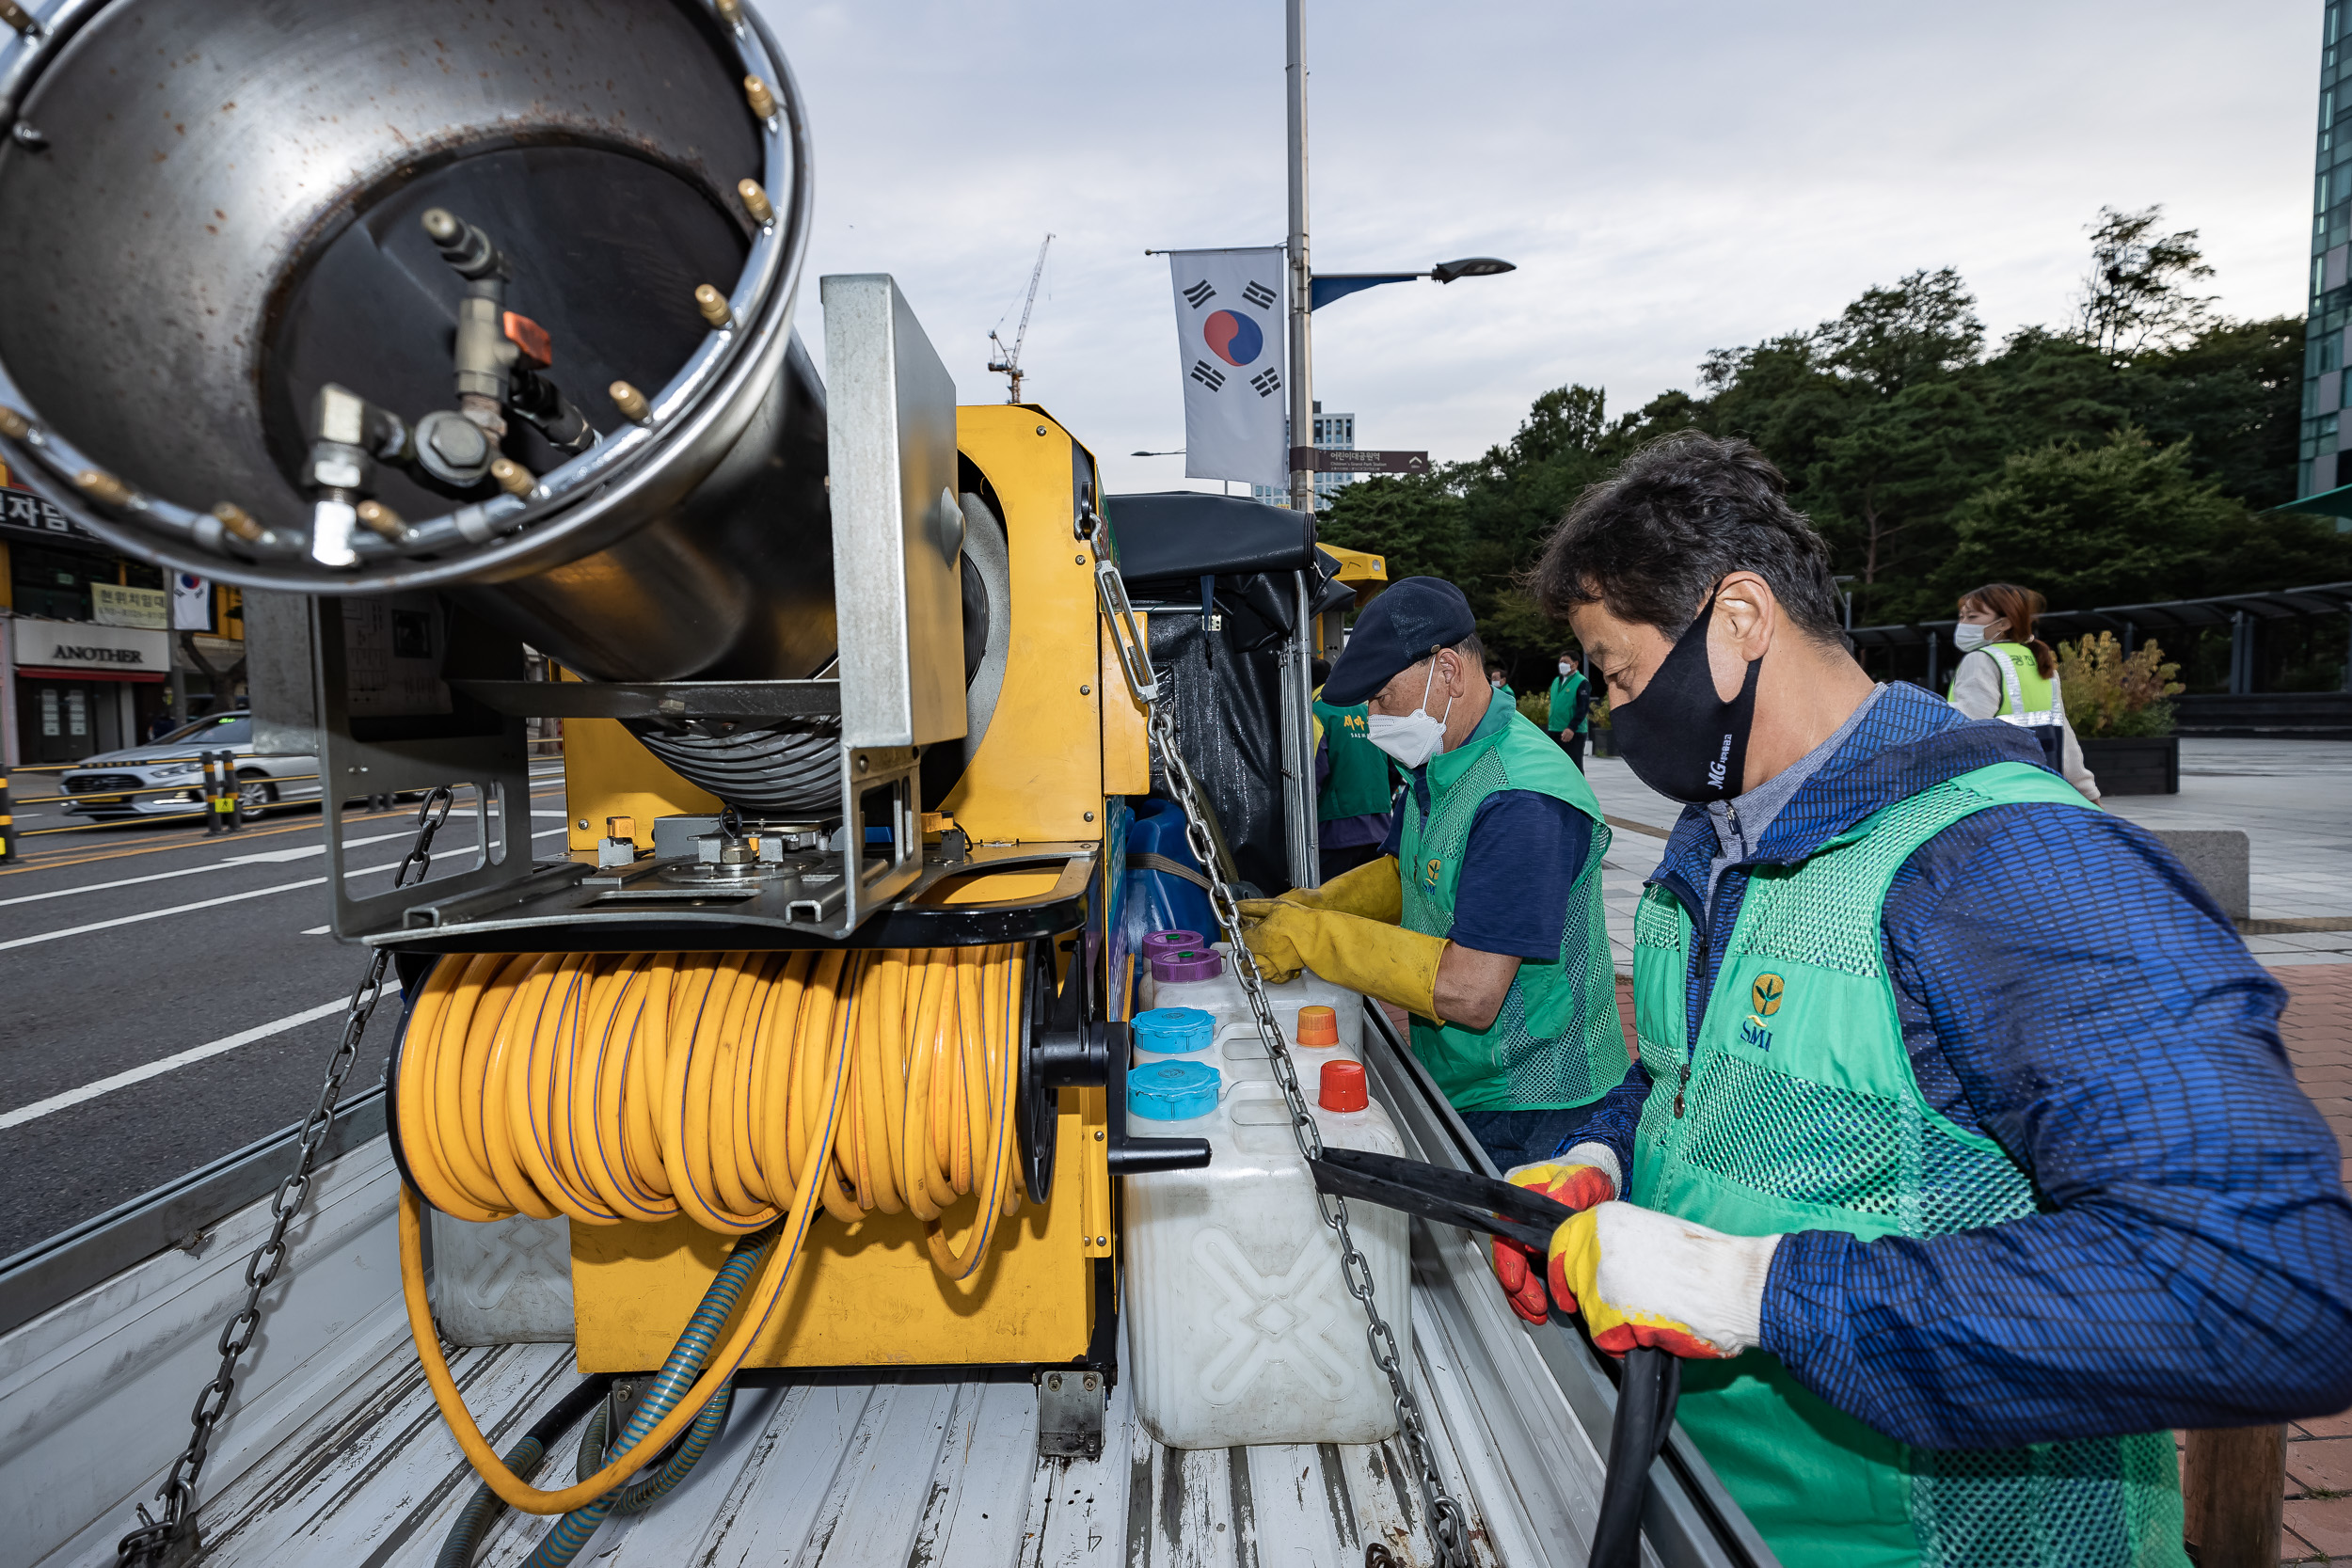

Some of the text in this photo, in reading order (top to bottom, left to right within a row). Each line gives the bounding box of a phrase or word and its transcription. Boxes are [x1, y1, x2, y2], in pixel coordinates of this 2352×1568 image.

[1330, 451, 1380, 461] 어린이대공원역
[0, 491, 87, 536] 자담
[53, 644, 143, 663] ANOTHER
[1343, 714, 1369, 731] 새마
[1707, 760, 1726, 790] MG
[1740, 1021, 1773, 1052] SMI
